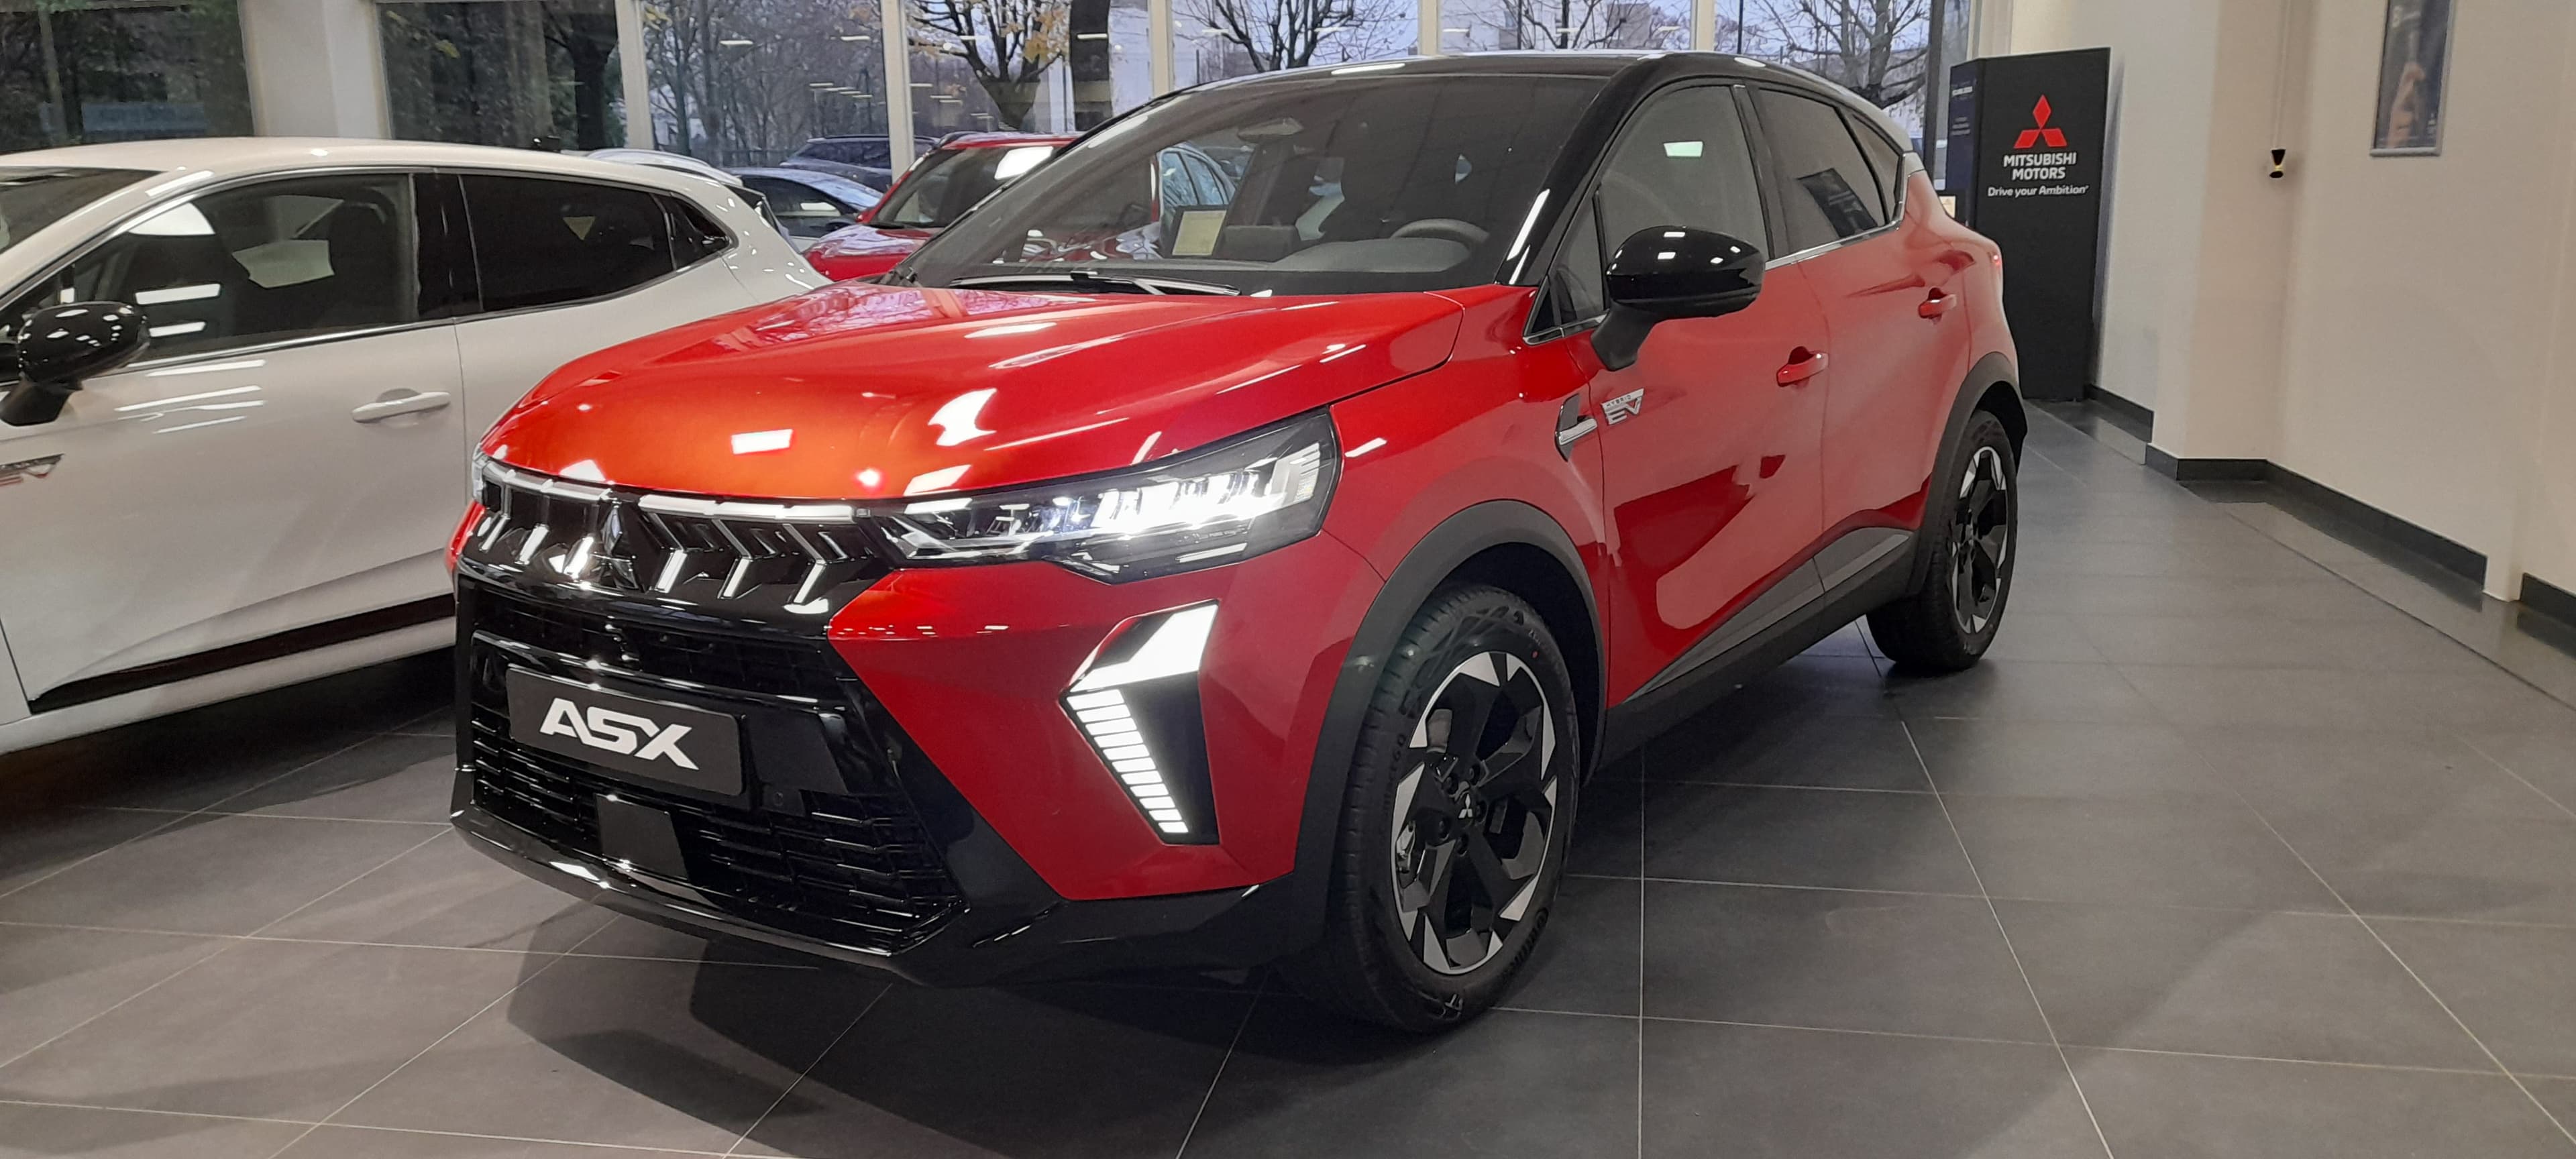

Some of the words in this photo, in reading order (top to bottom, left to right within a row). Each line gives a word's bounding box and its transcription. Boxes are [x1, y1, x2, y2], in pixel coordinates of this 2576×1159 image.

[2004, 152, 2077, 167] MITSUBISHI
[2012, 167, 2066, 180] MOTORS
[1988, 186, 2013, 197] Drive
[2015, 187, 2037, 198] your
[1603, 394, 1642, 425] EV
[540, 698, 699, 770] ASX
